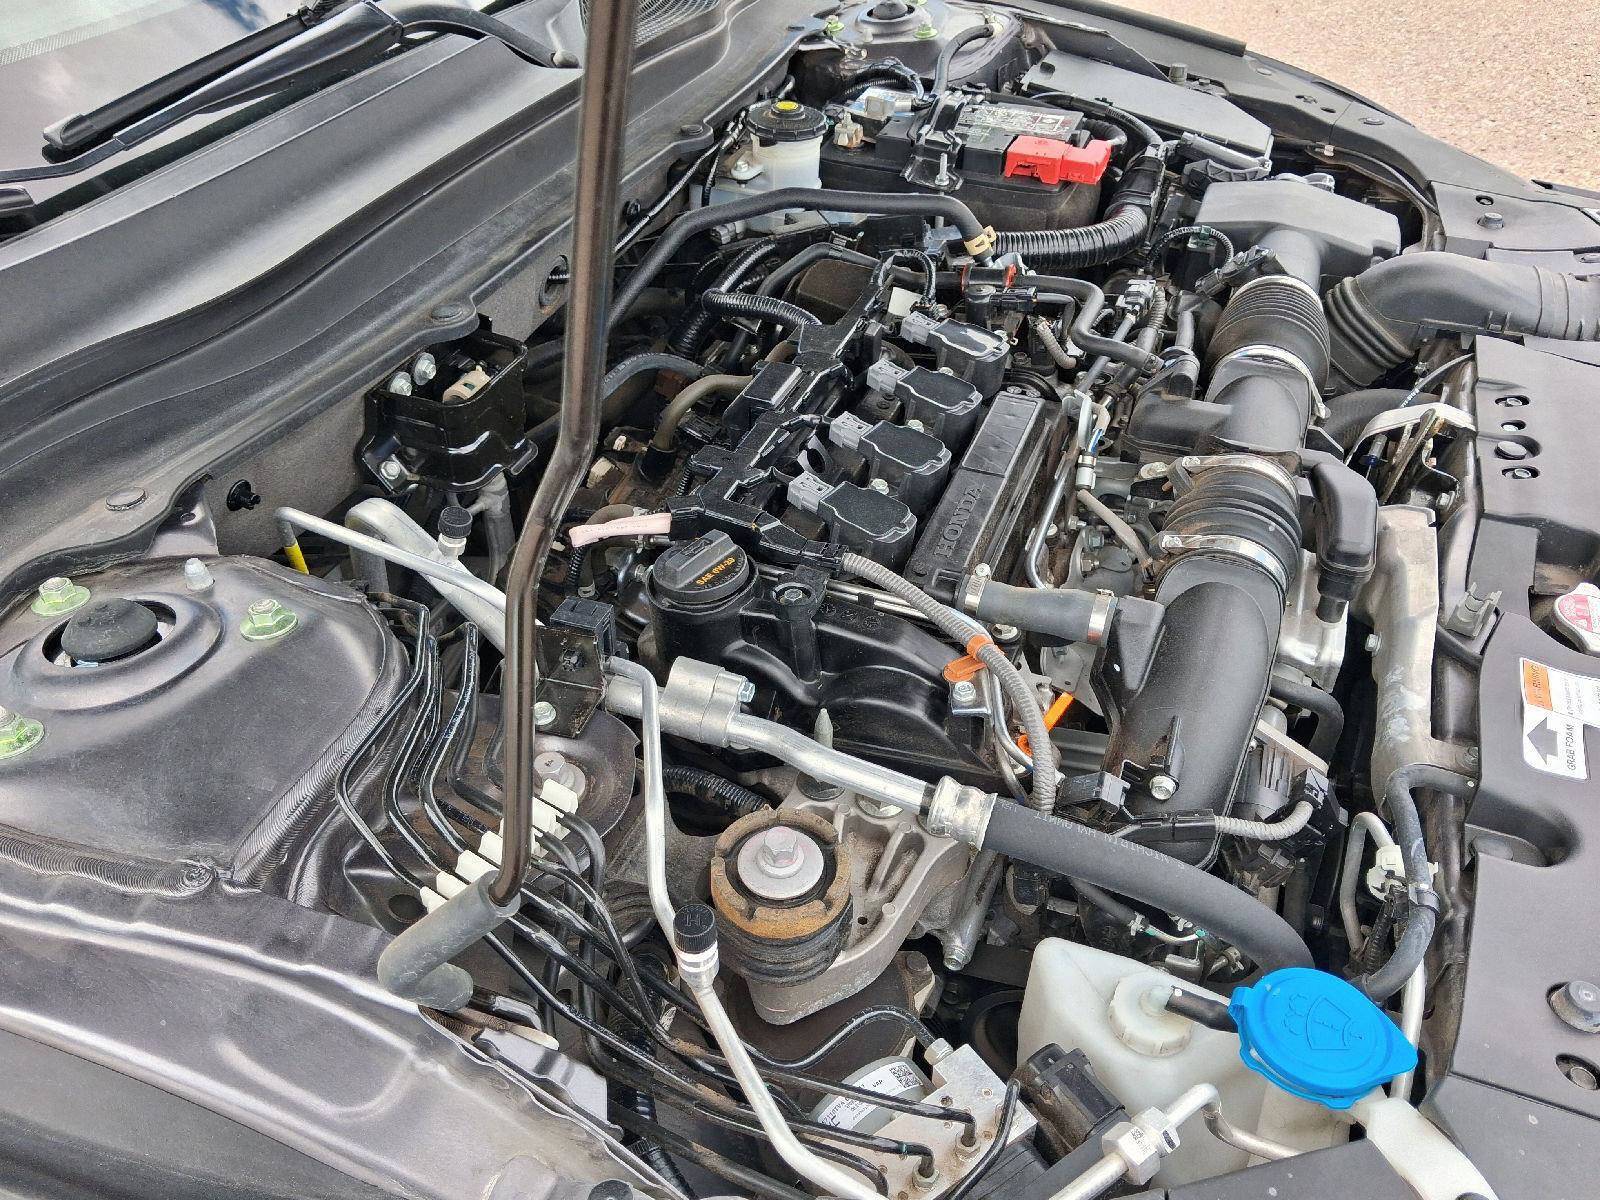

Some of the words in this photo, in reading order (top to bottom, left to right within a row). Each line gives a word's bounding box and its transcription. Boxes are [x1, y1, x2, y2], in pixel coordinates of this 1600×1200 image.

[933, 485, 985, 558] HONDA
[696, 572, 715, 586] SAE
[1566, 724, 1575, 748] FOAM
[1566, 749, 1576, 770] GRAB
